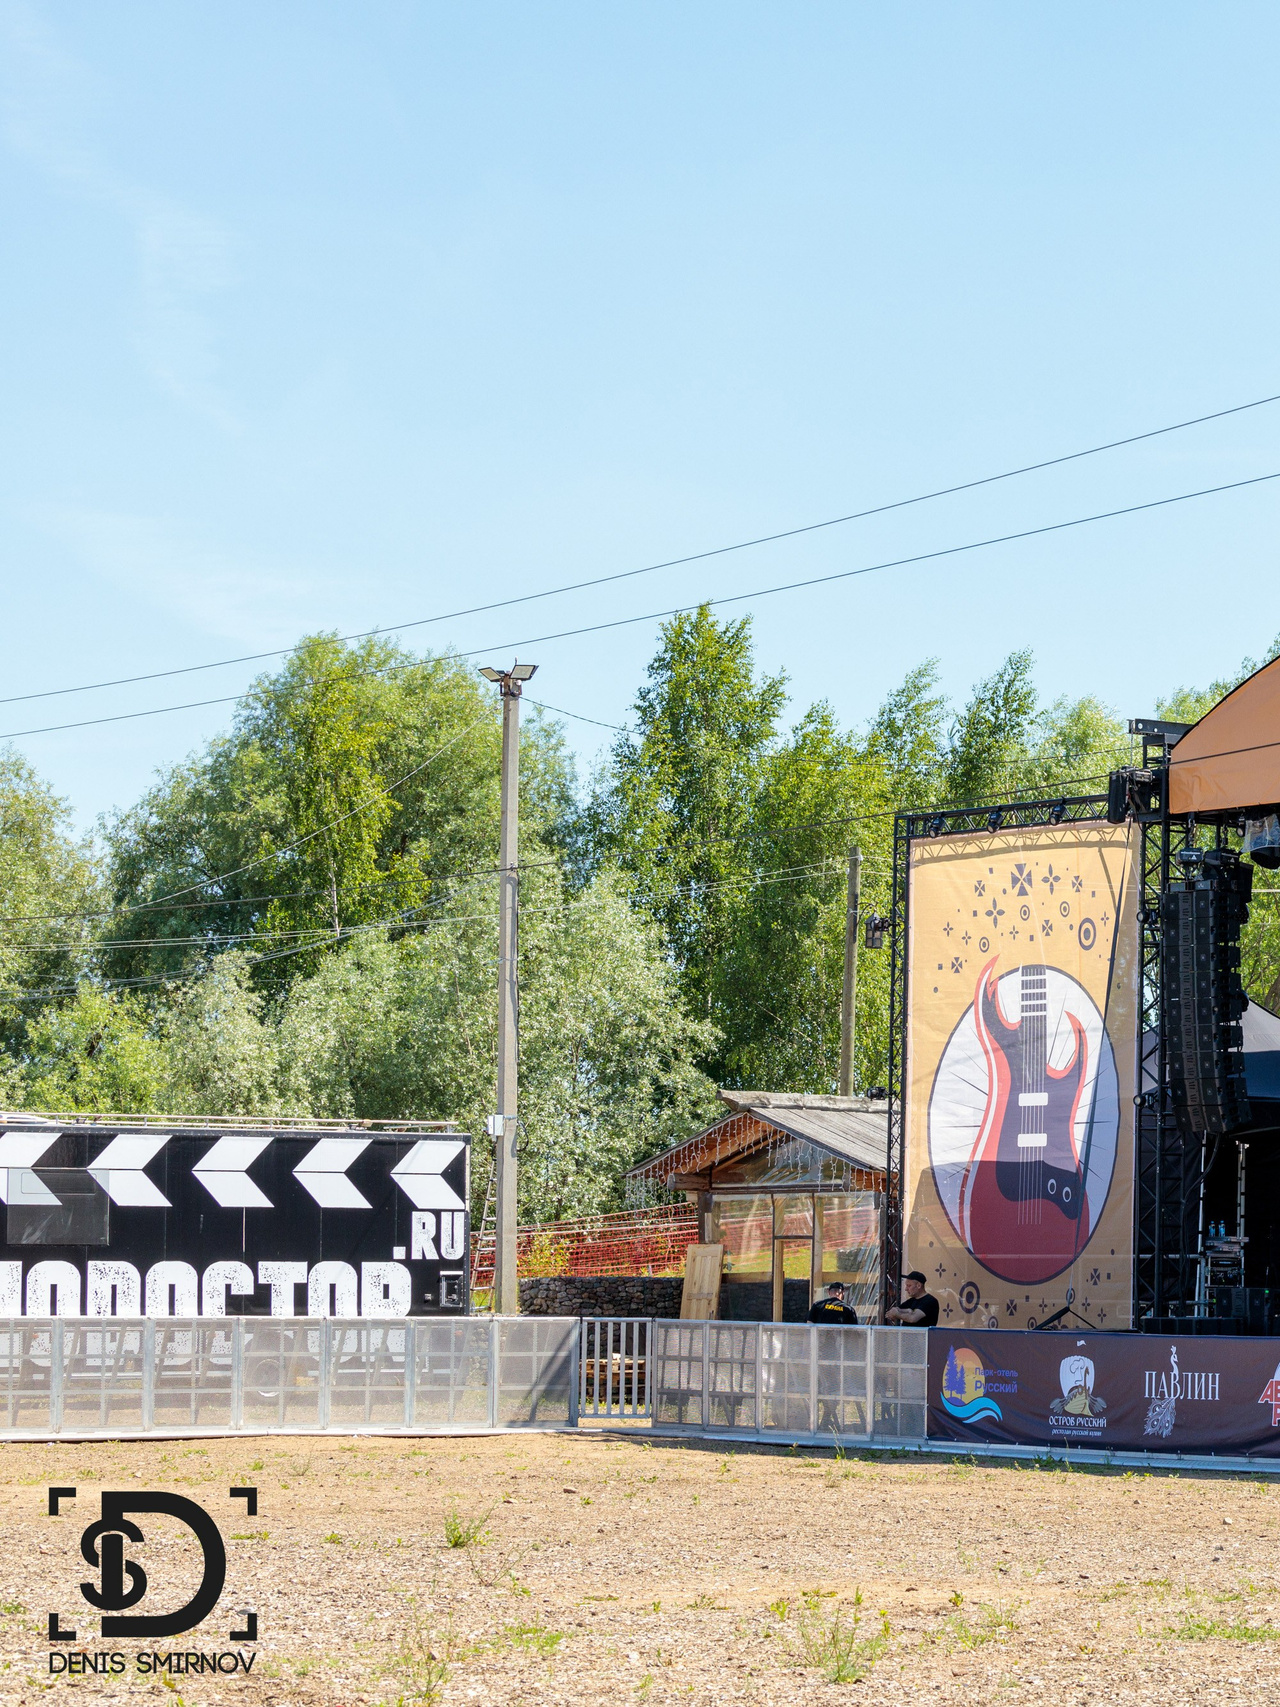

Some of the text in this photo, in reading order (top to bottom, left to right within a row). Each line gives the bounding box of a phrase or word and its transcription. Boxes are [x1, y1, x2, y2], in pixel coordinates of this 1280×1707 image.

[974, 1367, 1019, 1378] Парк-отель
[974, 1380, 1018, 1394] Русский
[1144, 1371, 1220, 1400] ПАВЛИН
[1049, 1416, 1107, 1427] ОСТРОВ РУССКИЙ
